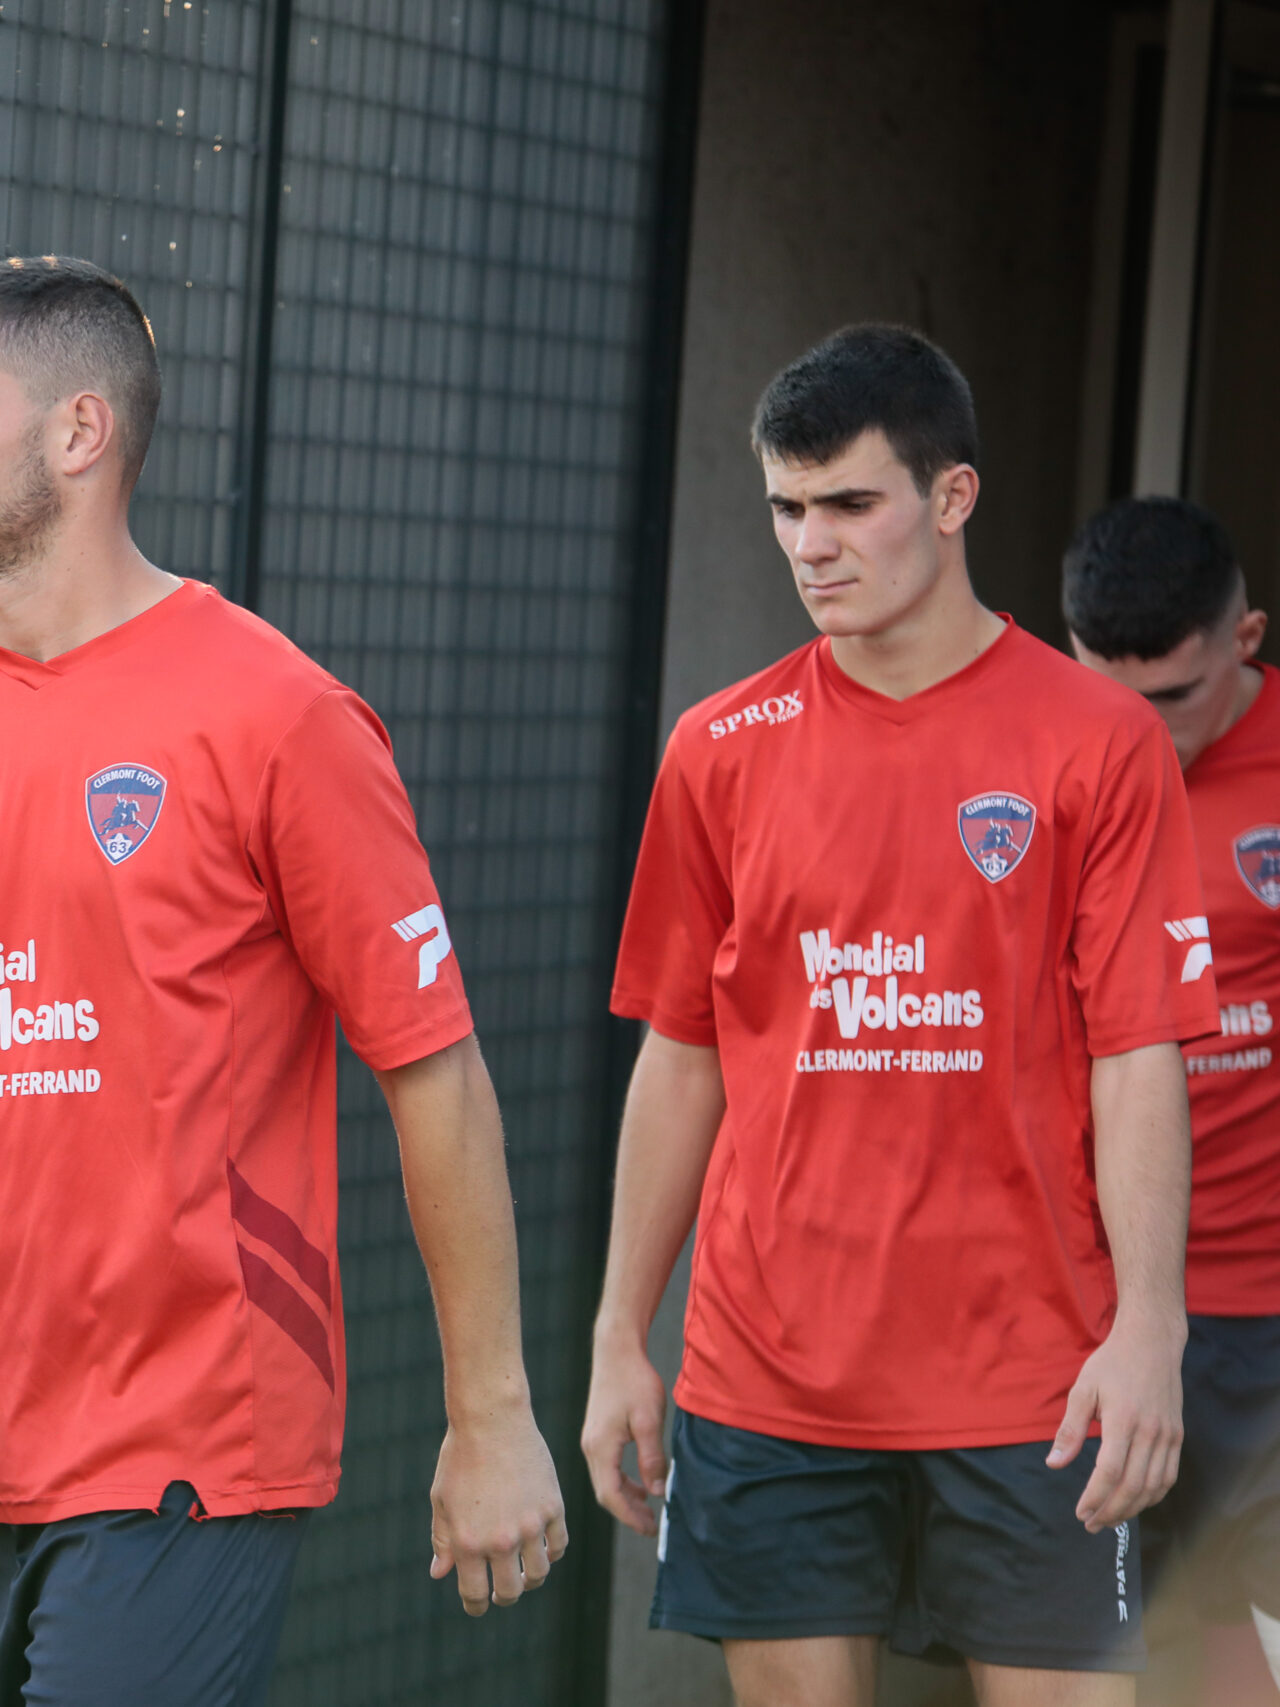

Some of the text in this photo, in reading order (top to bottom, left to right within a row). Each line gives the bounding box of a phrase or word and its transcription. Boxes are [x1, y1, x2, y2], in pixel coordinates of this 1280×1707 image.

[709, 688, 804, 740] SPROX
[93, 769, 160, 789] CLERMONT FOOT
[965, 797, 1030, 816] CLERMONT FOOT
[109, 841, 127, 853] 63
[799, 928, 924, 983] Mondial
[831, 975, 984, 1039] Volcans
[796, 1049, 983, 1073] CLERMONT-FERRAND
